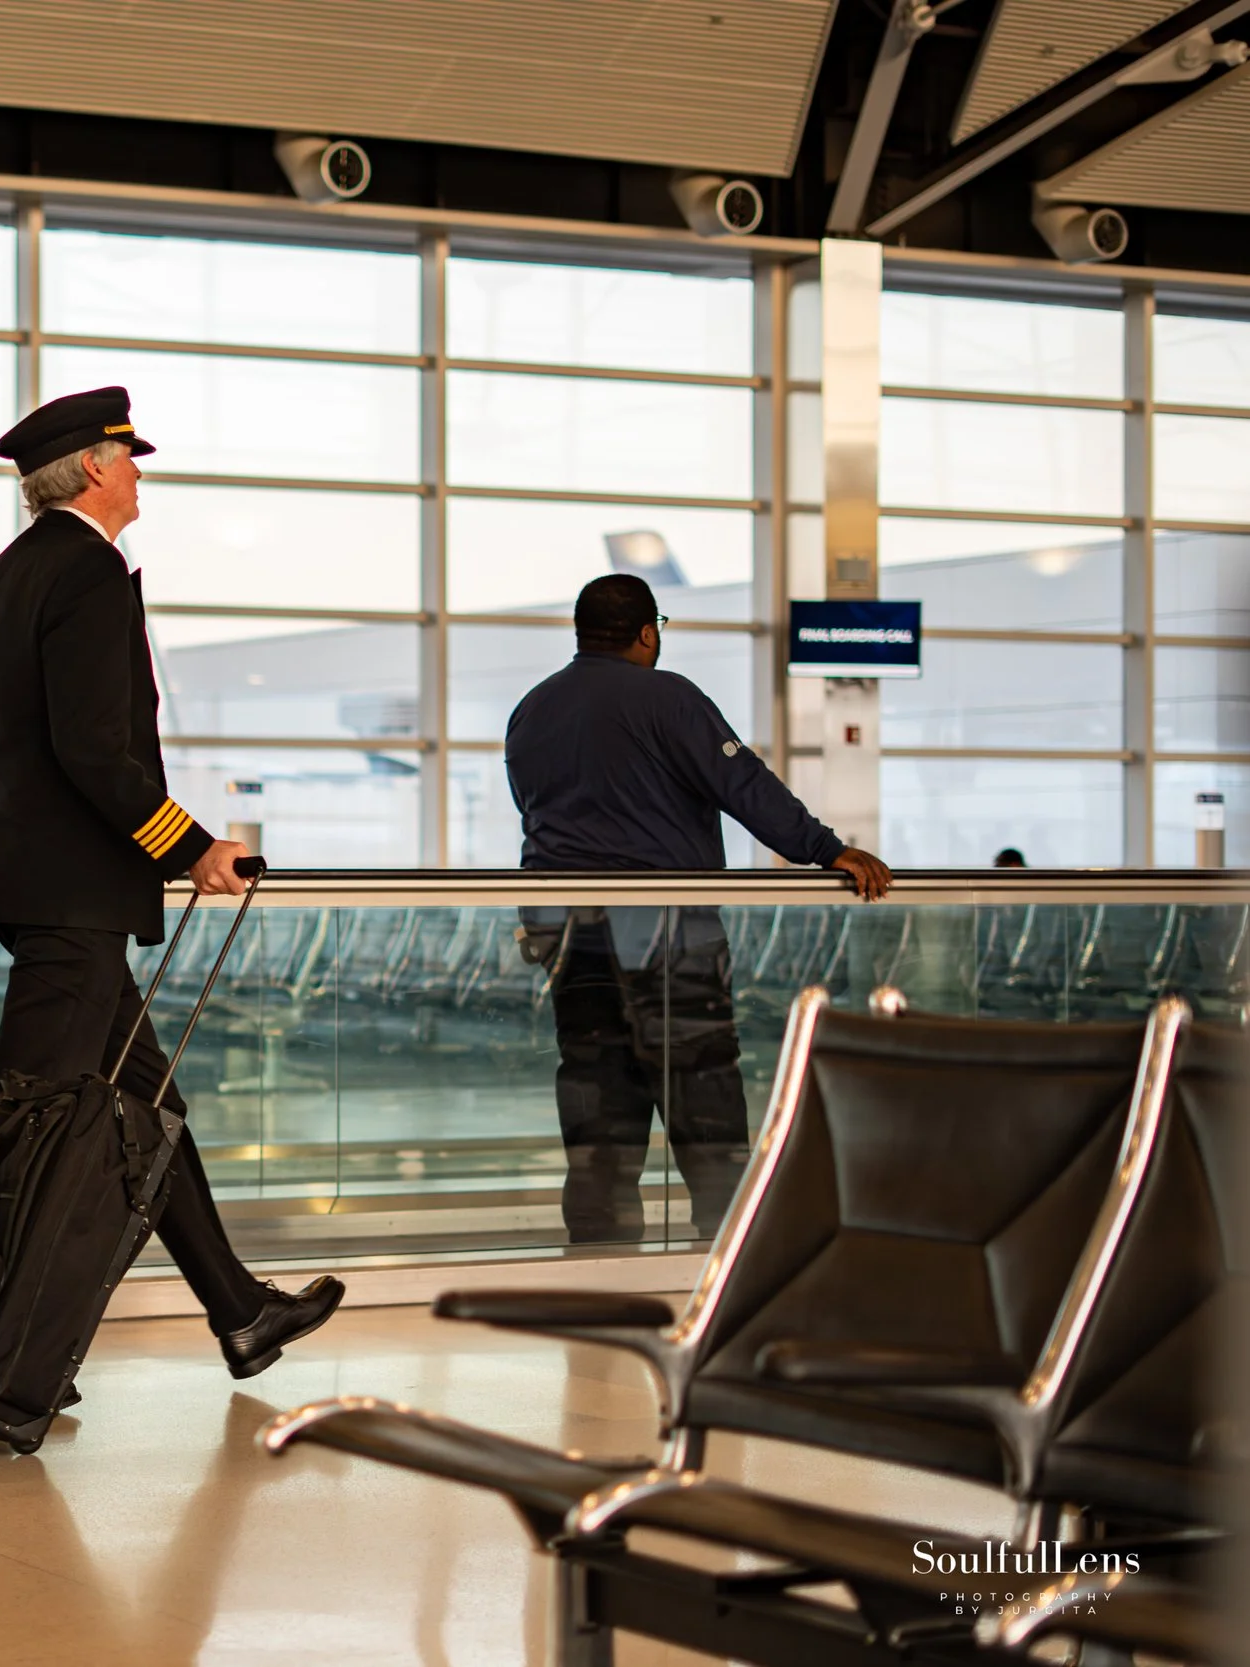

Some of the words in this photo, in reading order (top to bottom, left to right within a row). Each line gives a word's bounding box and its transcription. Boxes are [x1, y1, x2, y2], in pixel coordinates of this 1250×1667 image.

[799, 627, 830, 642] FINAL
[830, 628, 885, 643] BOARDING
[886, 629, 913, 643] CALL
